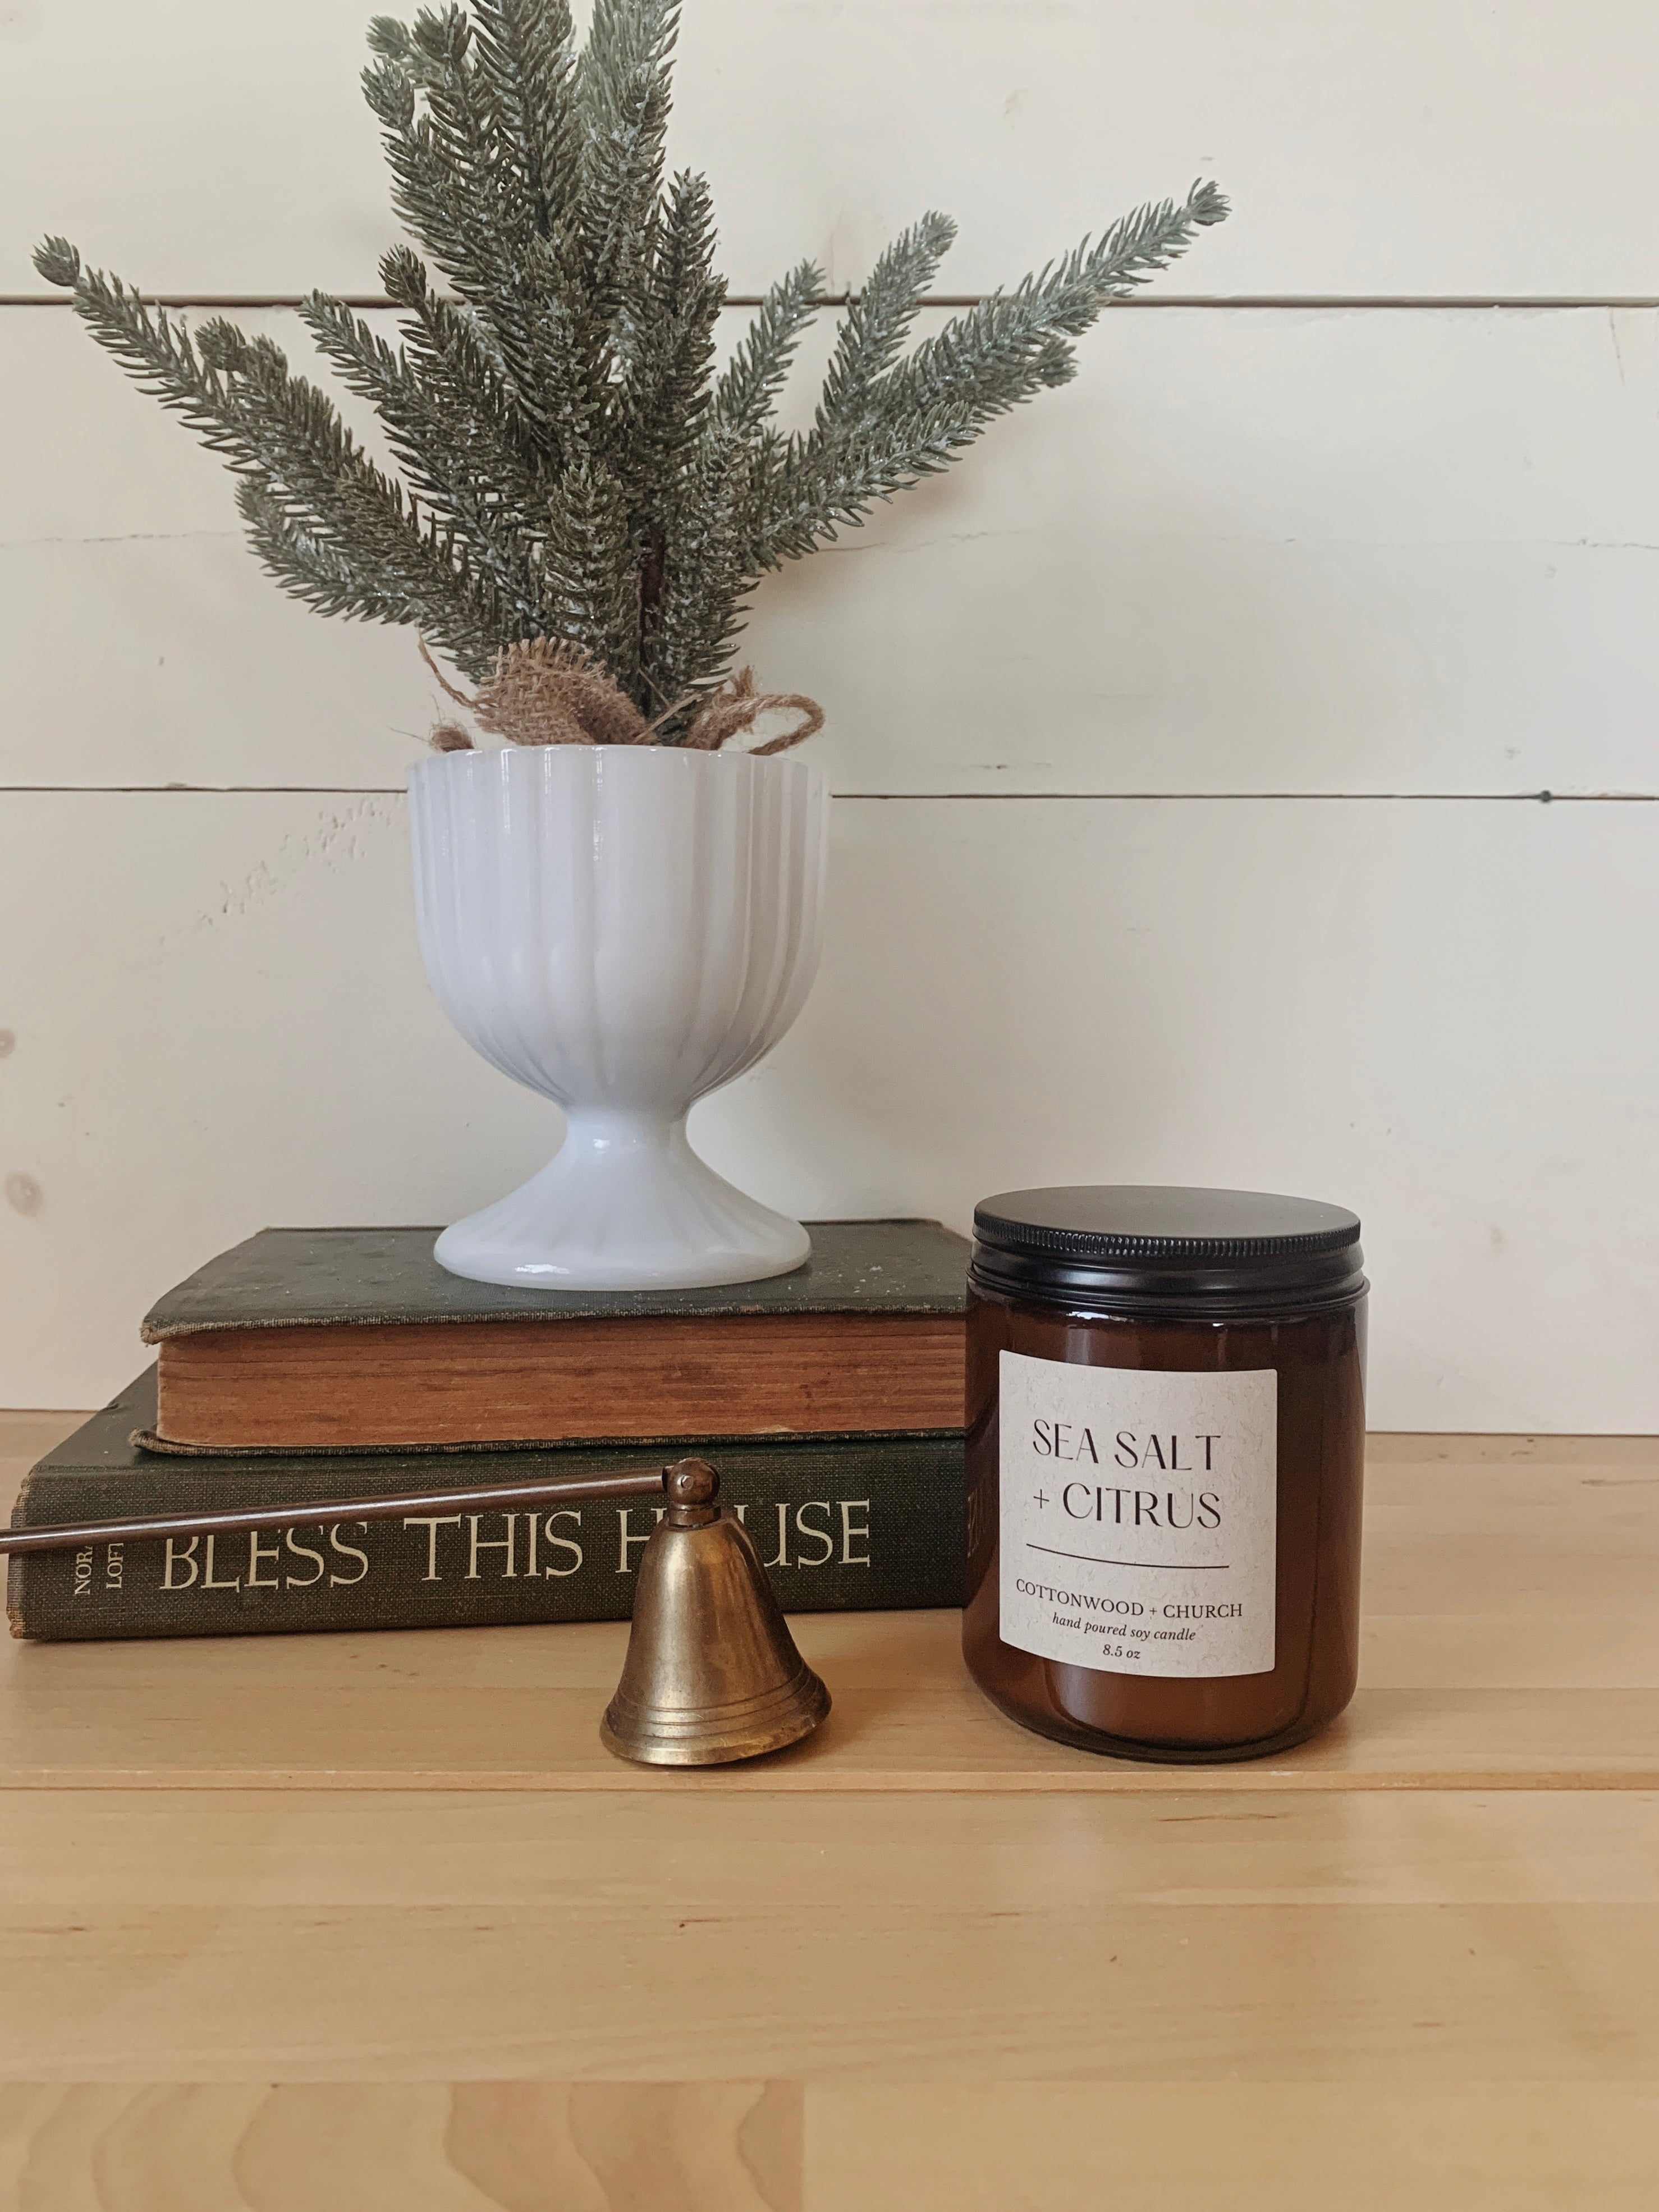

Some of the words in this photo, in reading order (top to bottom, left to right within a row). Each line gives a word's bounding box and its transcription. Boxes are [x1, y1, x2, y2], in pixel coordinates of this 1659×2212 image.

[1032, 1418, 1099, 1464] SEA
[1113, 1431, 1222, 1471] SALT
[1033, 1488, 1050, 1509] +
[1062, 1482, 1222, 1529] CITRUS
[159, 1521, 369, 1593] BLESS
[403, 1510, 583, 1581] THIS
[615, 1498, 870, 1573] HUSE
[1016, 1578, 1144, 1616] COTTONWOOD
[1149, 1607, 1158, 1615] +
[1163, 1603, 1243, 1619] CHURCH
[1052, 1611, 1081, 1629] hand
[1083, 1622, 1127, 1637] poured
[1130, 1628, 1151, 1642] soy
[1153, 1628, 1197, 1641] candle
[1102, 1643, 1123, 1657] 8.5
[1126, 1649, 1142, 1660] oz
